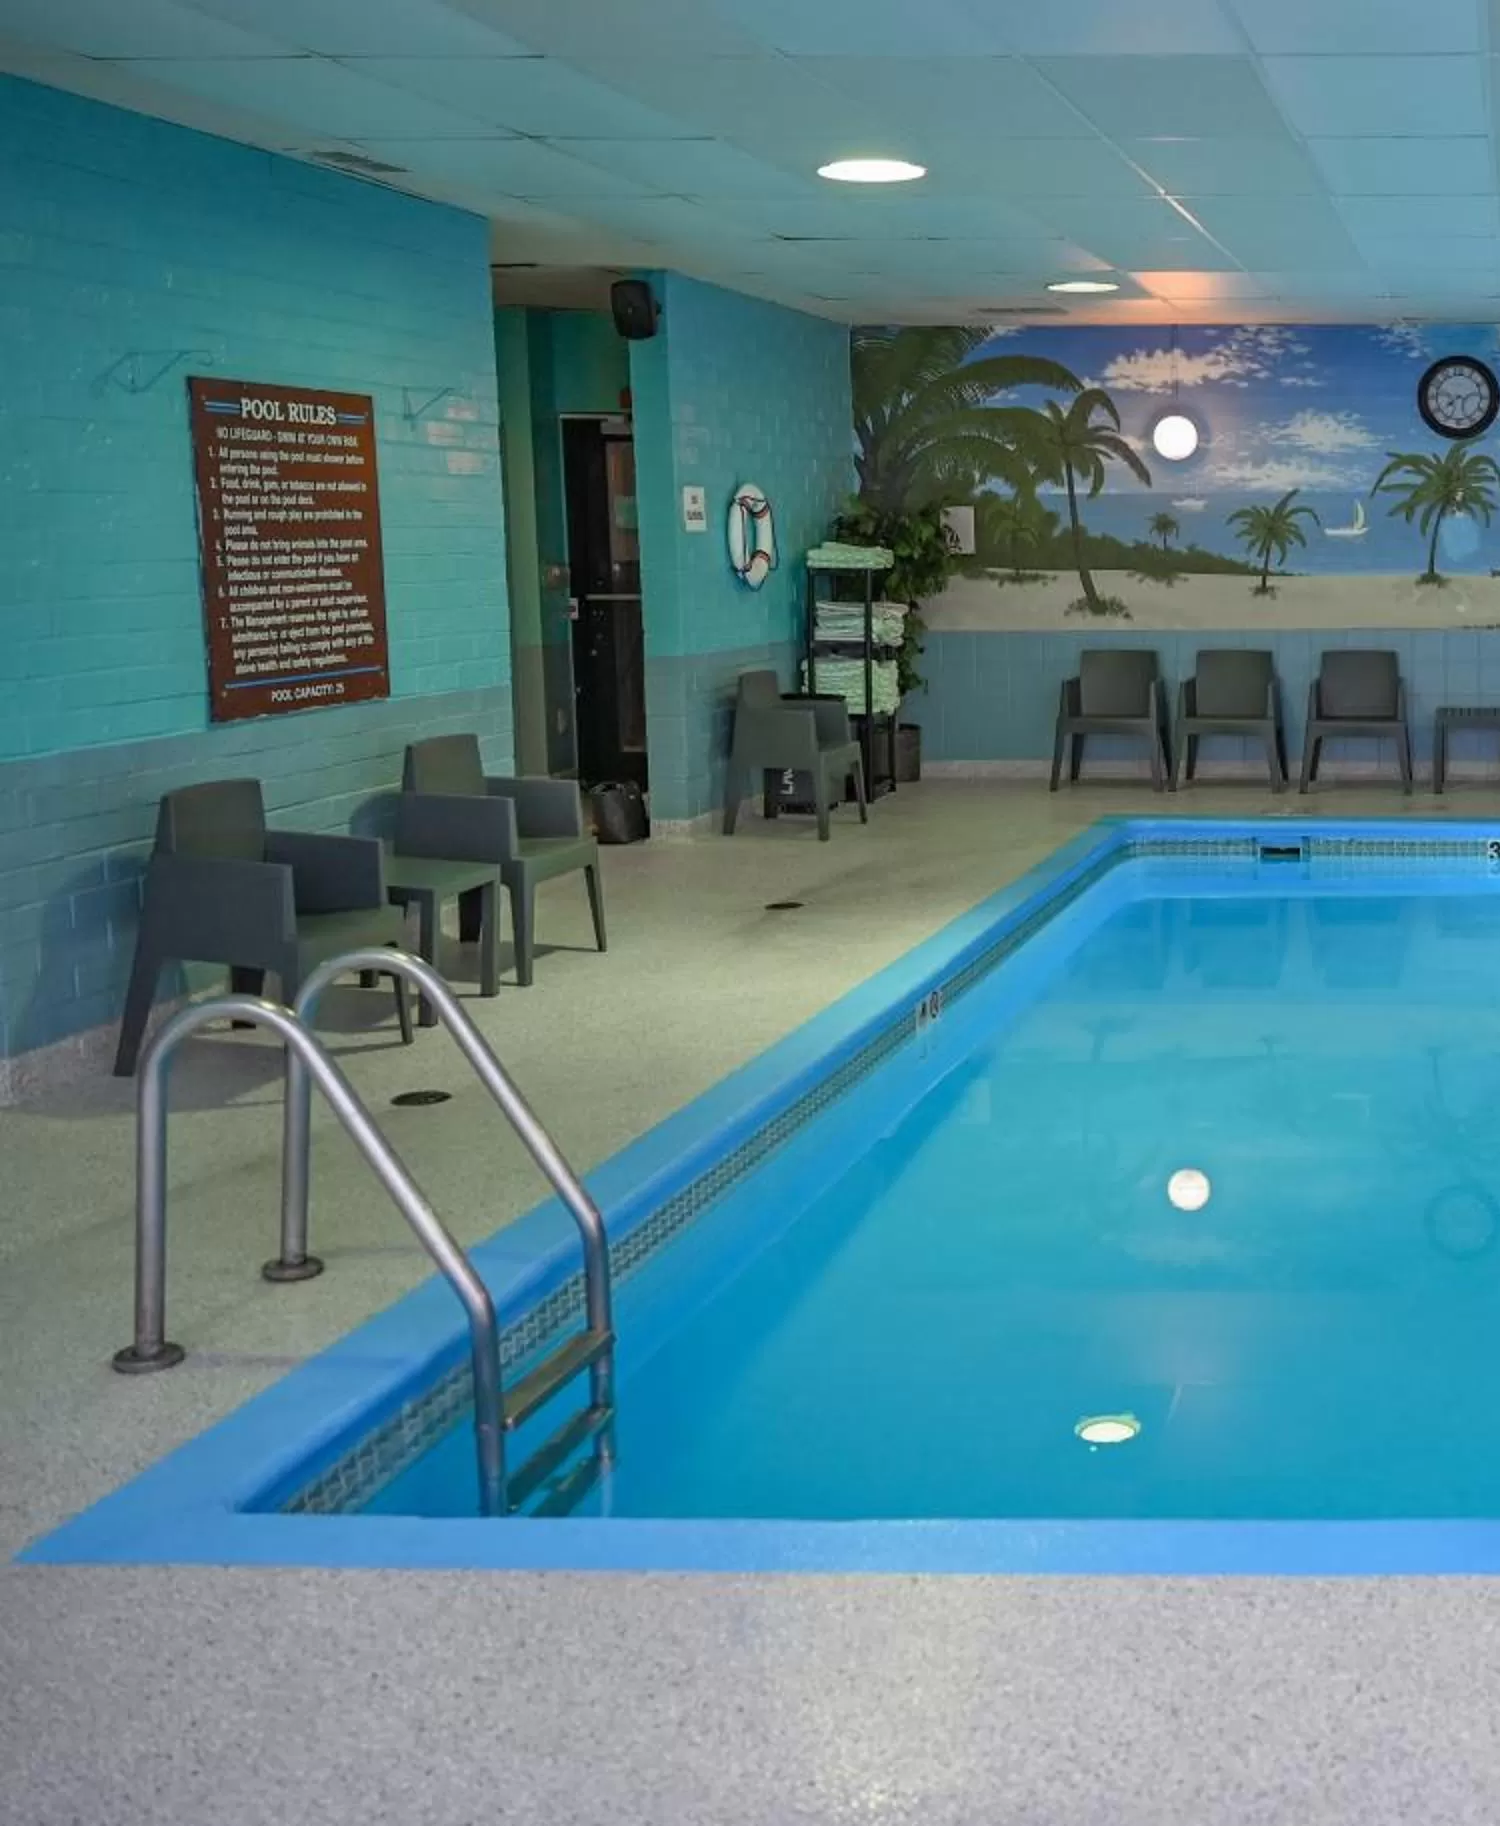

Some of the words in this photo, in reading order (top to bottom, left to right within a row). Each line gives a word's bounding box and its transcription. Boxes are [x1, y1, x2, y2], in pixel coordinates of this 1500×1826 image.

[241, 397, 285, 421] POOL
[288, 402, 337, 425] RULES
[230, 427, 272, 441] LIFEGUARD
[220, 445, 228, 458] All
[279, 450, 289, 461] the
[290, 451, 304, 464] pool
[250, 464, 260, 475] the
[222, 493, 234, 505] the
[235, 493, 251, 507] pool
[253, 508, 267, 520] and
[224, 525, 241, 538] pool
[232, 616, 245, 628] The
[272, 688, 294, 702] POOL
